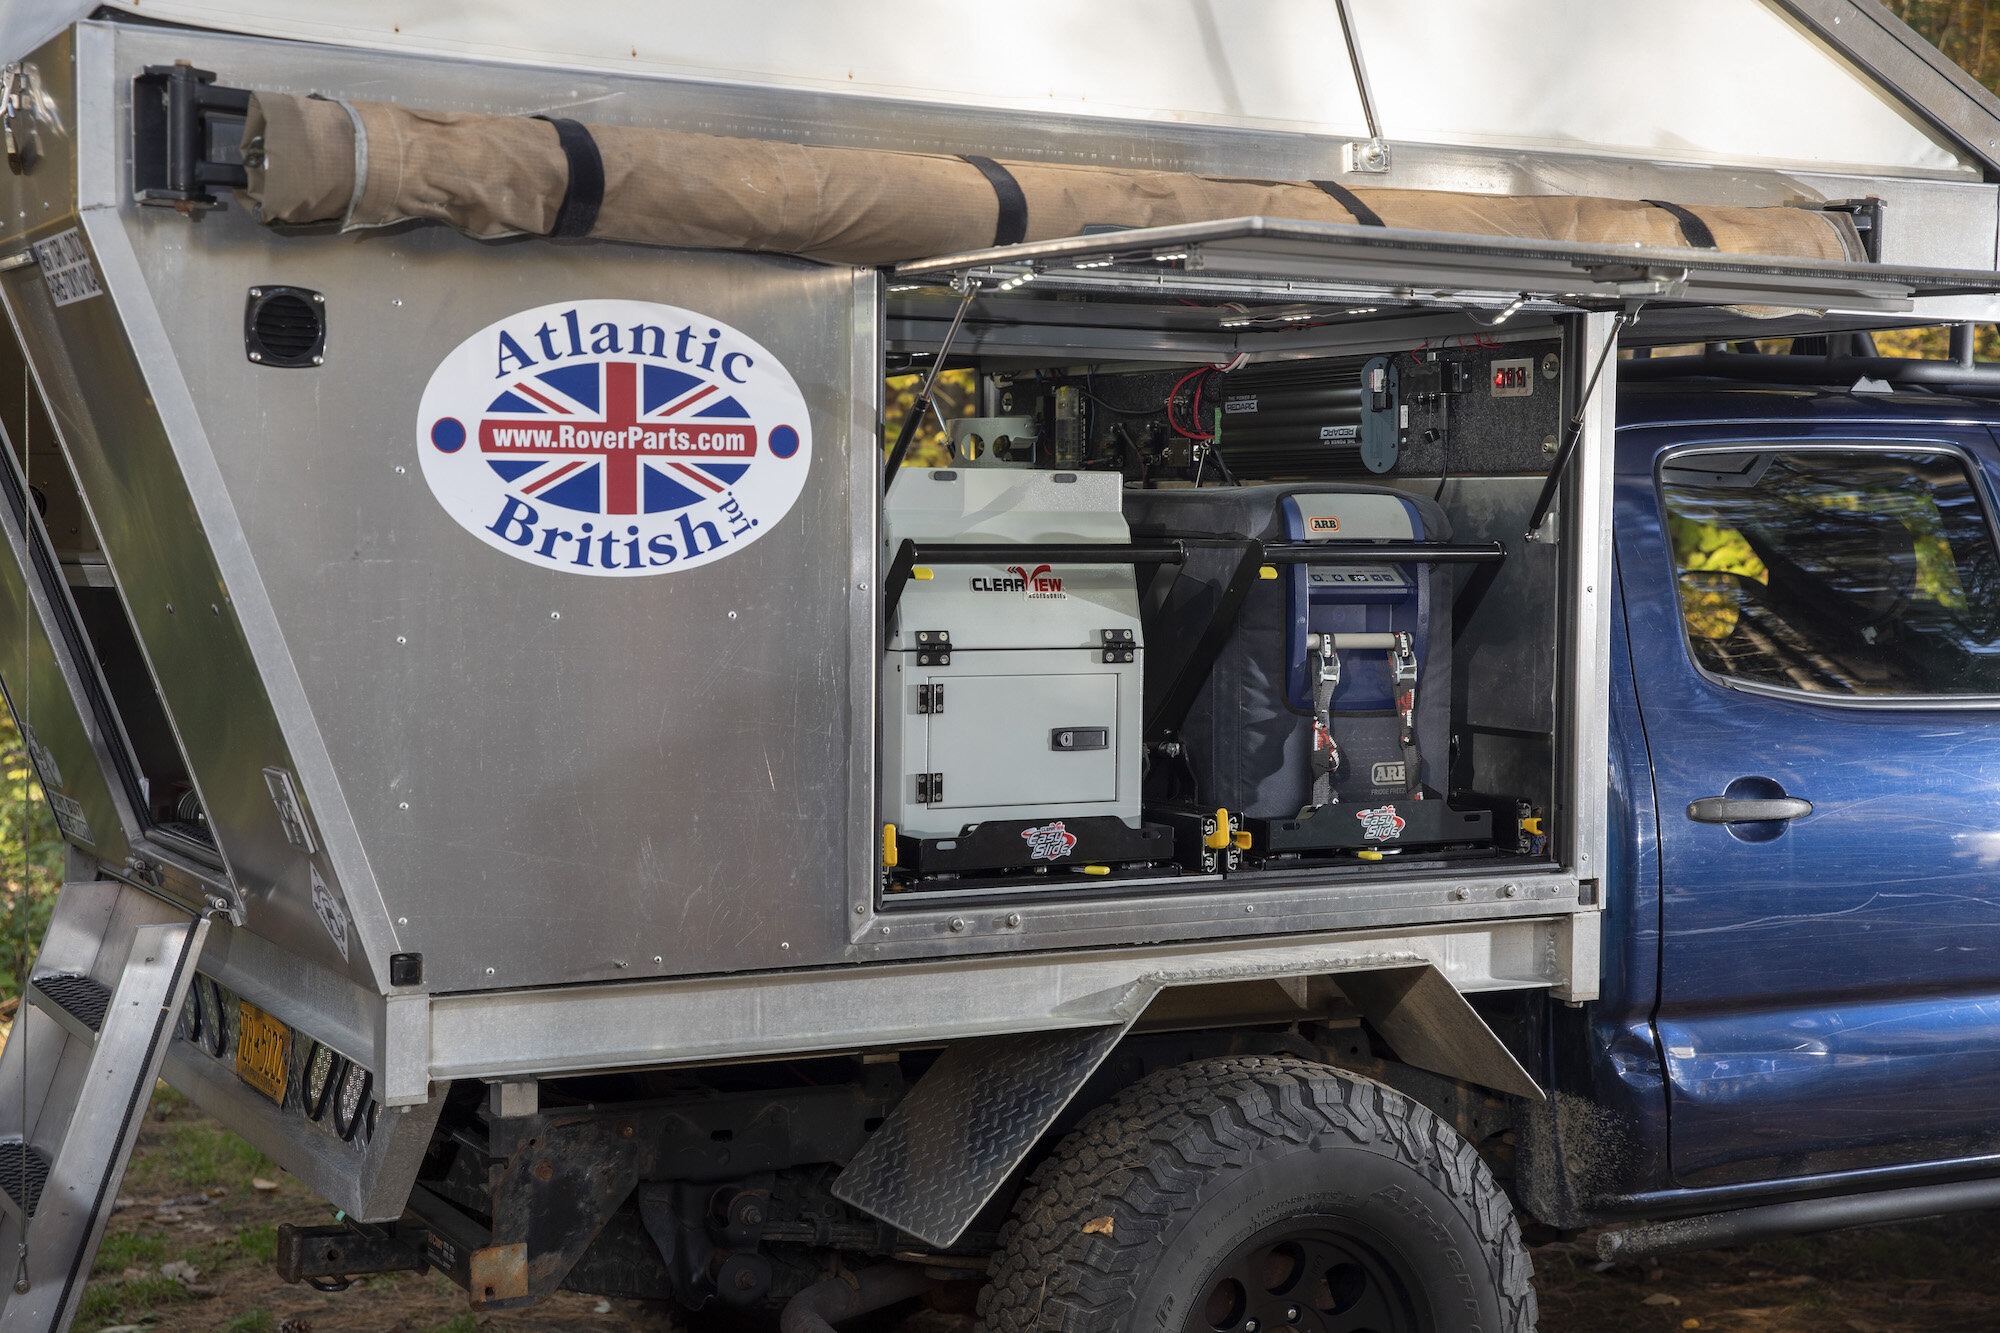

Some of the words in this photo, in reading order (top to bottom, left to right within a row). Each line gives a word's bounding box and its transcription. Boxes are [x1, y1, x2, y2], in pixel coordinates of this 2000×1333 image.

[495, 309, 754, 384] Atlantic
[1226, 402, 1256, 411] REDARC
[492, 424, 745, 452] www.RoverParts.com
[1323, 428, 1354, 437] REDARC
[485, 493, 728, 570] British
[1314, 520, 1337, 529] ARB
[972, 564, 1063, 592] CLEARVIEW
[1366, 825, 1399, 838] Slide
[1033, 842, 1070, 857] Slide
